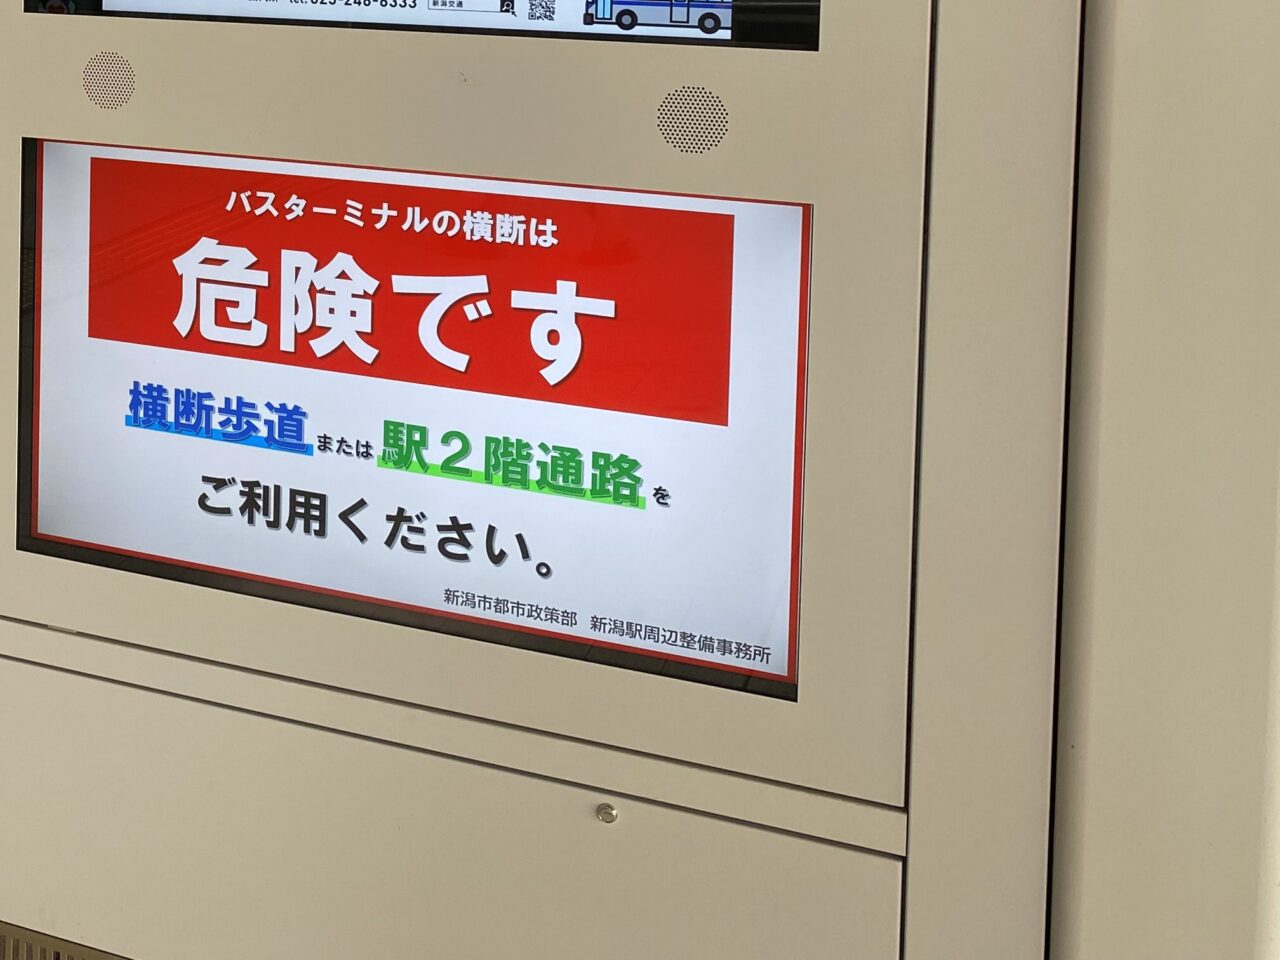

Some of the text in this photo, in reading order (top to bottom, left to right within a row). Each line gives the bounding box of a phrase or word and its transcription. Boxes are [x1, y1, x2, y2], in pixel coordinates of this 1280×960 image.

[432, 0, 464, 8] 新潟交通
[225, 189, 559, 247] バスターミナルの横断は
[172, 236, 616, 386] 危険です
[128, 380, 672, 508] 横断歩道 または 駅2階通路 を
[195, 472, 556, 579] ご利用ください。
[442, 588, 772, 666] 新潟市都市政策部 新潟駅周辺整備事務所
